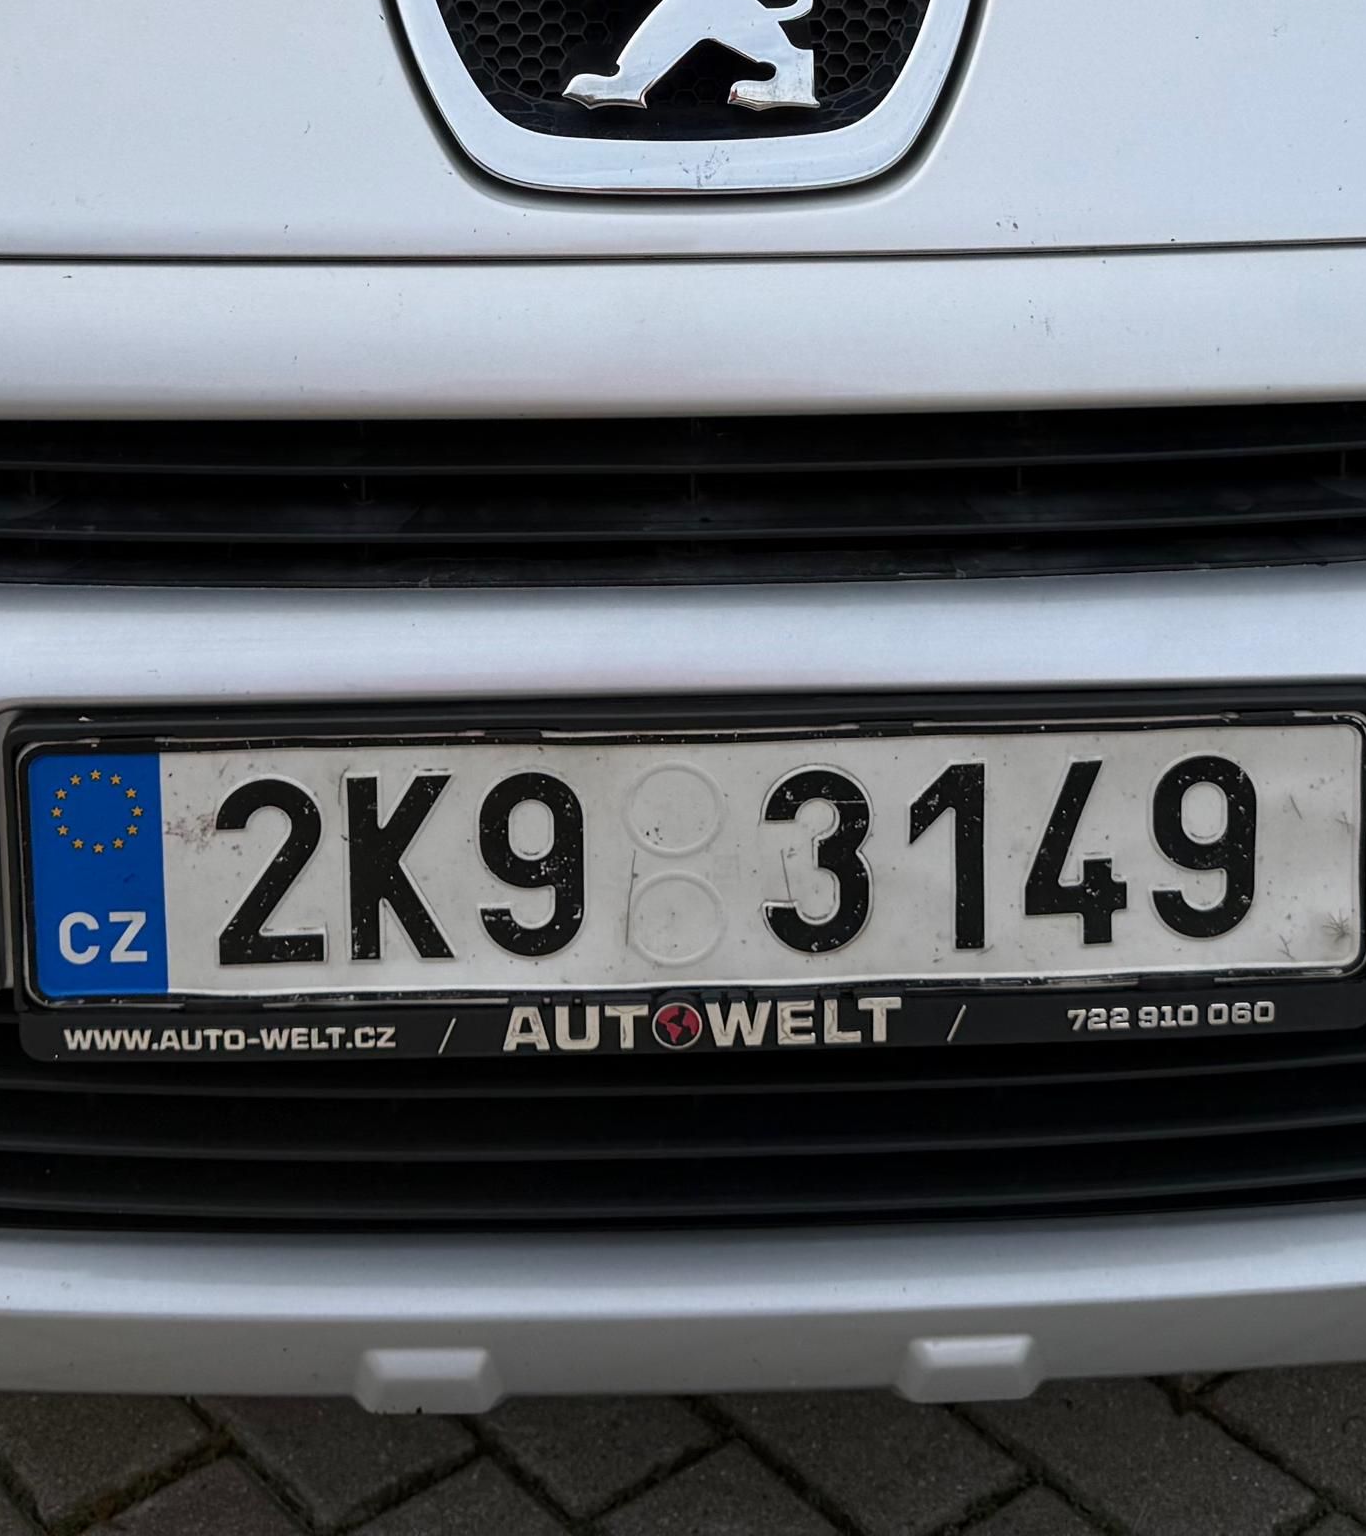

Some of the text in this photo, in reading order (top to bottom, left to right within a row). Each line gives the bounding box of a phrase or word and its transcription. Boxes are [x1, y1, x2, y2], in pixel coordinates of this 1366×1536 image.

[213, 753, 1261, 966] 2K9 3149
[57, 910, 149, 964] CZ
[63, 1025, 397, 1052] WWW.AUTO-WELT.CZ
[1066, 1007, 1131, 1032] 722
[1137, 1004, 1200, 1028] 910
[1206, 1000, 1276, 1026] 060
